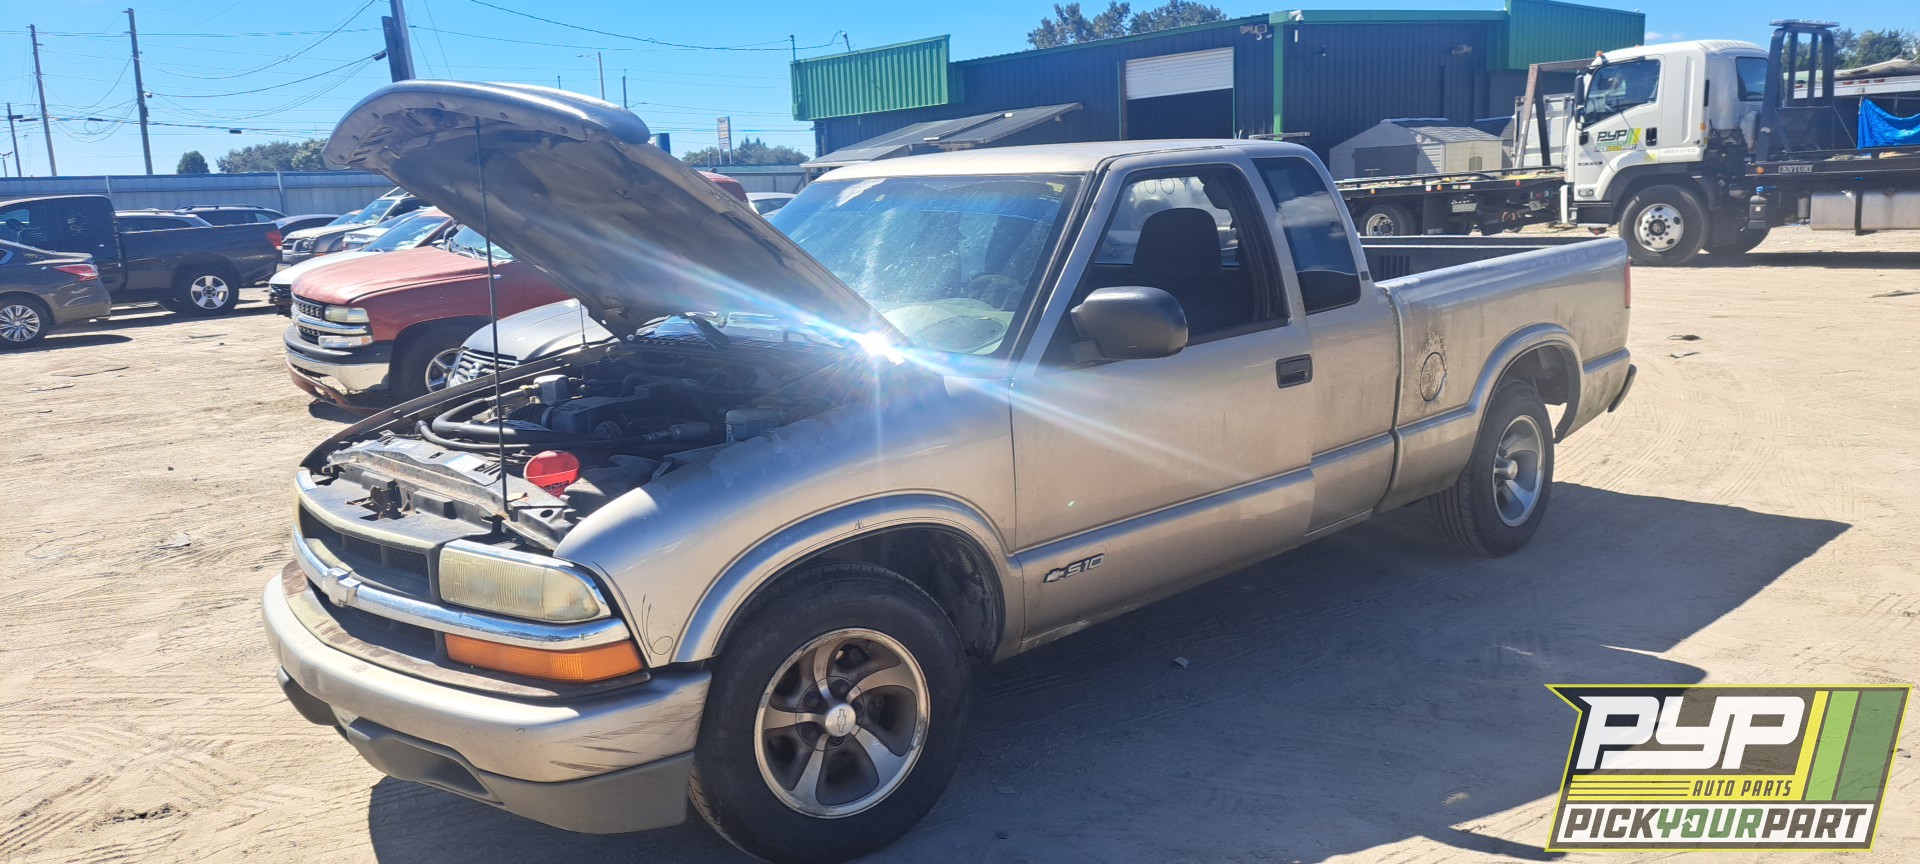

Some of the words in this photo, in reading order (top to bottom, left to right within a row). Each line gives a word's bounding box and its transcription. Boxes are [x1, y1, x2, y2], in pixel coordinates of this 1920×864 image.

[1597, 129, 1627, 142] PYP
[1778, 164, 1813, 174] CENTURY
[1064, 554, 1104, 578] S10
